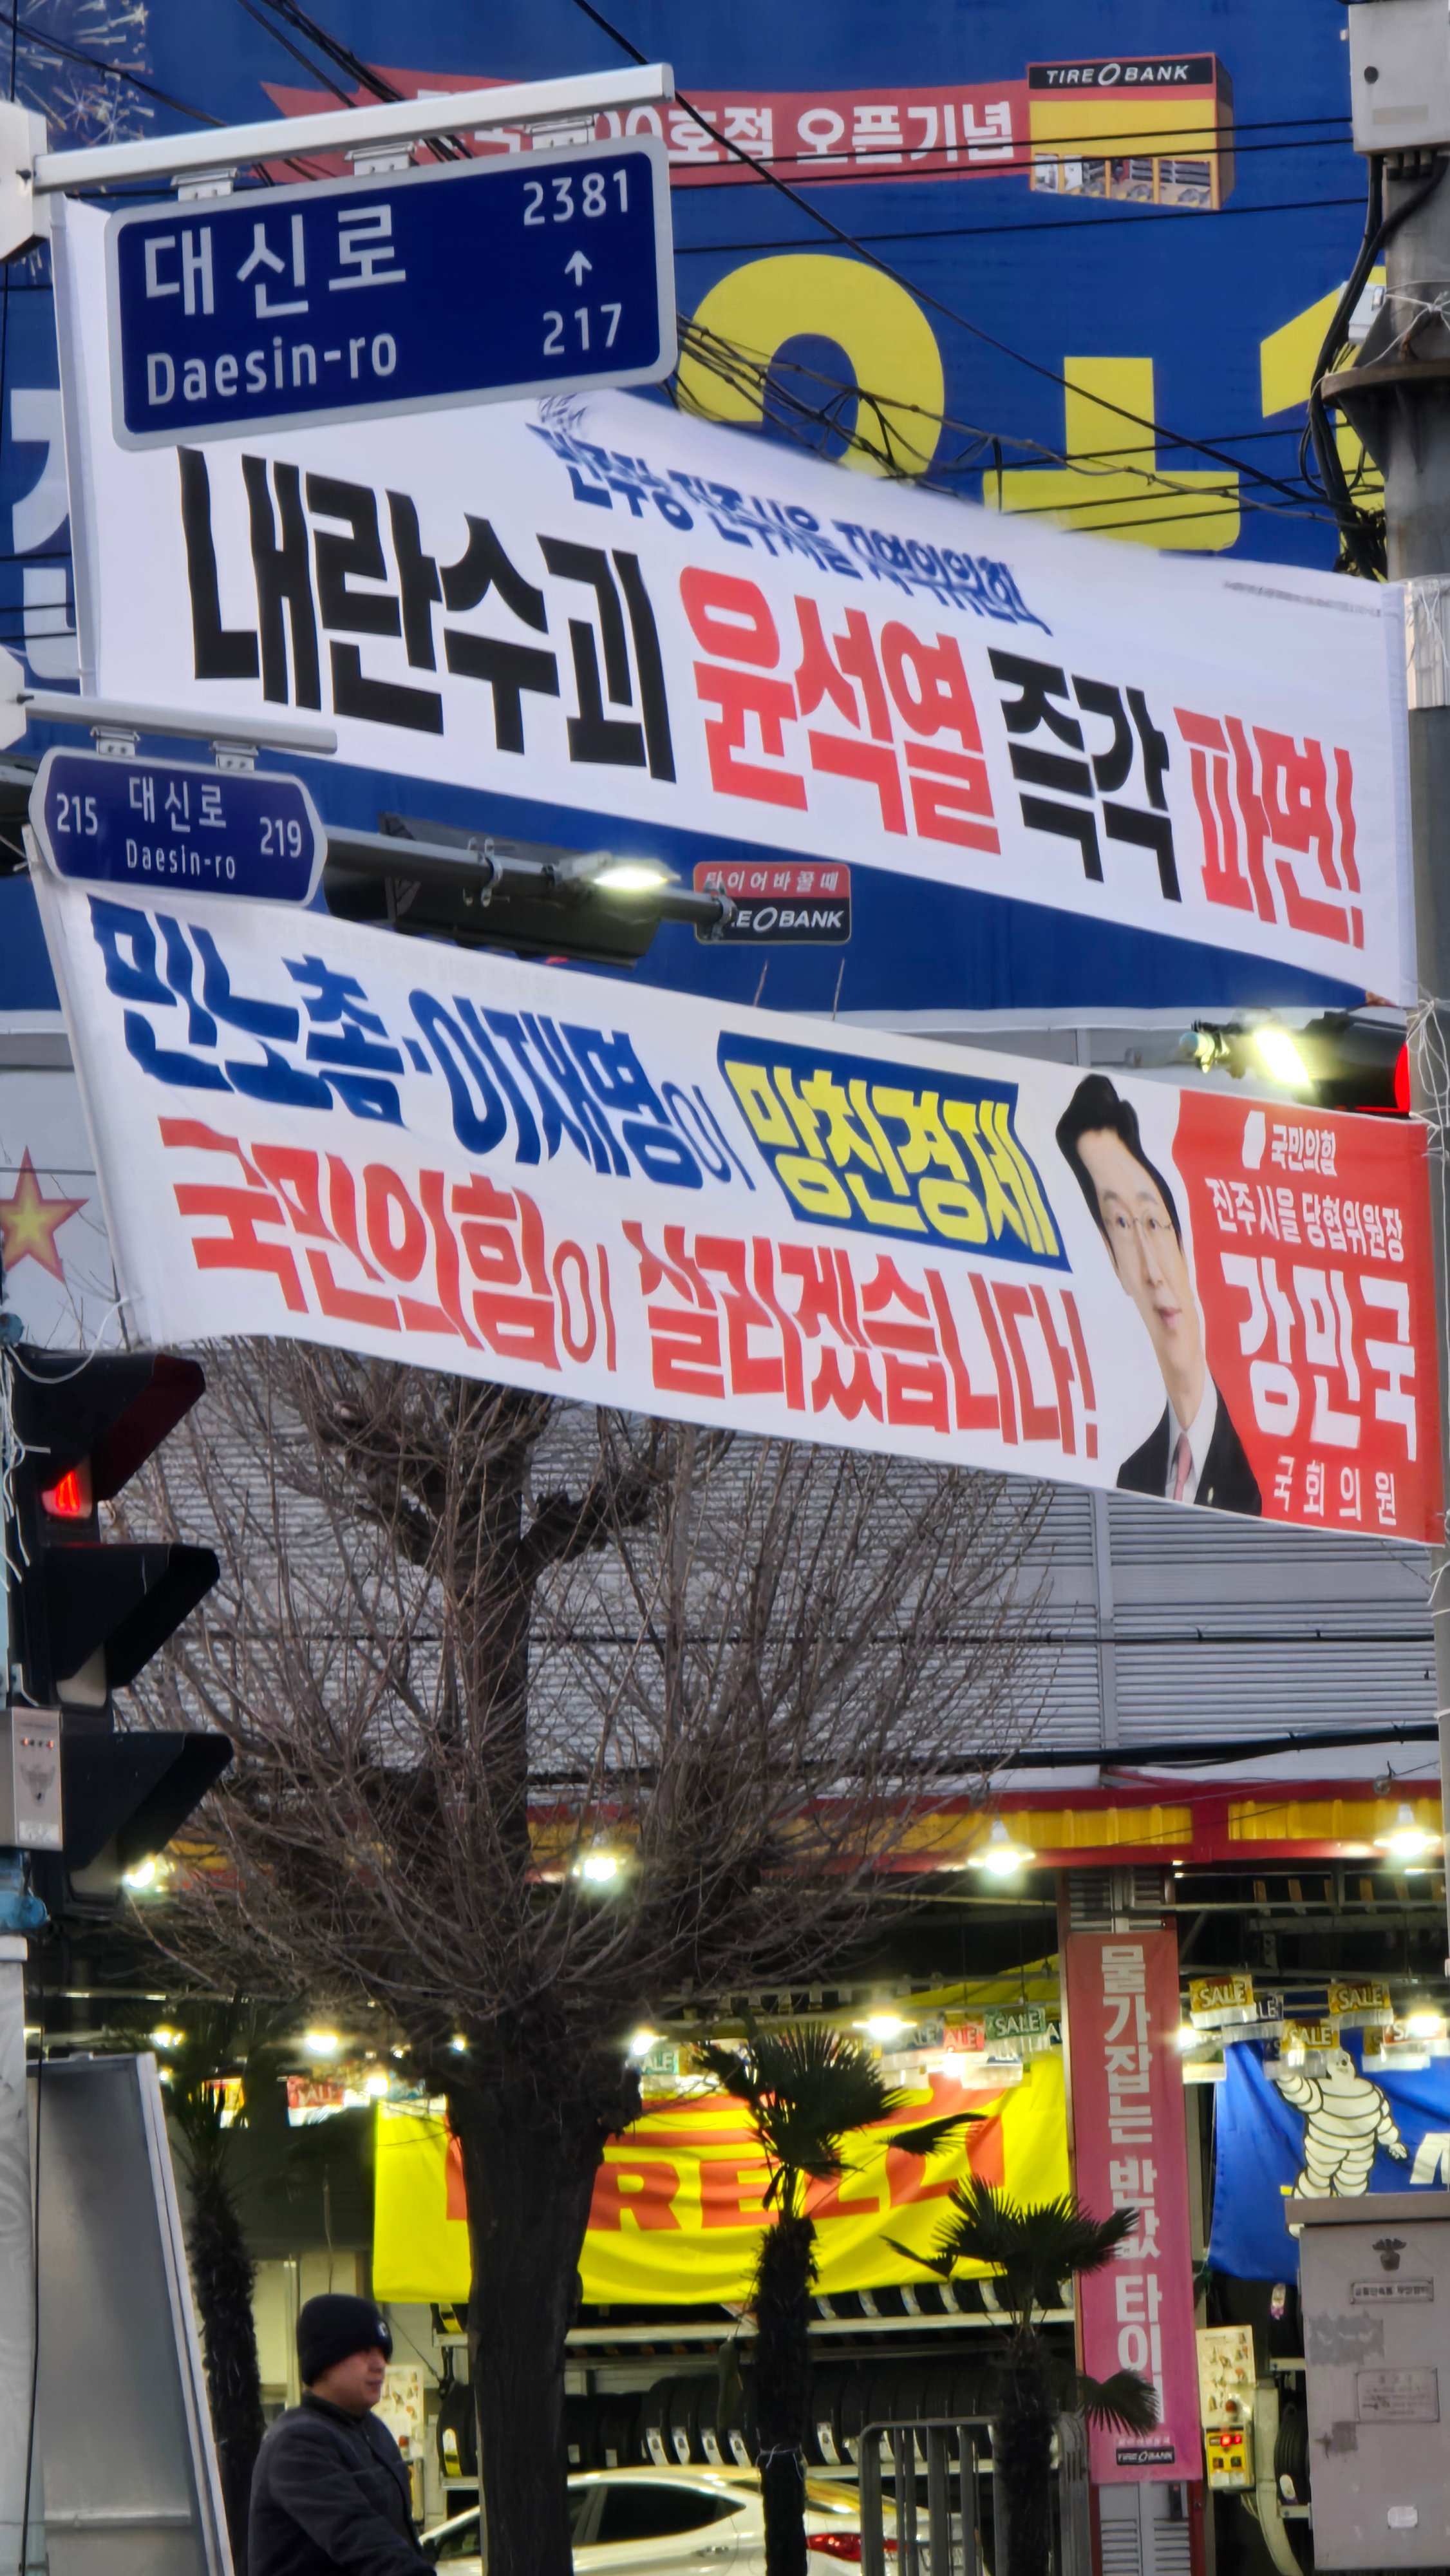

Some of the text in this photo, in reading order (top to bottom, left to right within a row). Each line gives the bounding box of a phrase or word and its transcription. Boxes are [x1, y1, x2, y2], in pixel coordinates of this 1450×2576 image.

[796, 100, 1014, 167] 오픈기념
[523, 169, 629, 226] 2381
[144, 205, 407, 318] 대신로
[542, 303, 623, 355] 217
[147, 333, 398, 406] Daesin-ro
[176, 445, 677, 784] 내란수괴
[679, 566, 1002, 855] 윤석열
[987, 646, 1182, 902] 즉각
[1173, 707, 1364, 951] 파면!
[56, 793, 99, 835] 215
[129, 775, 227, 833] 대신로
[125, 838, 236, 880] Daesin-ro
[259, 816, 303, 858] 219
[722, 1058, 1061, 1258] 망친경제
[1271, 1123, 1338, 1177] 국민의힘
[1205, 1177, 1405, 1263] 진주시을 당협위원장
[158, 1115, 1099, 1461] 국민의힘이 살리겠습니다!
[1219, 1251, 1418, 1462] 강민국
[994, 2007, 1040, 2038] SALE
[1200, 1978, 1246, 2009] SALE
[1337, 1985, 1384, 2011] SALE
[1101, 1944, 1153, 2145] 물가잡는
